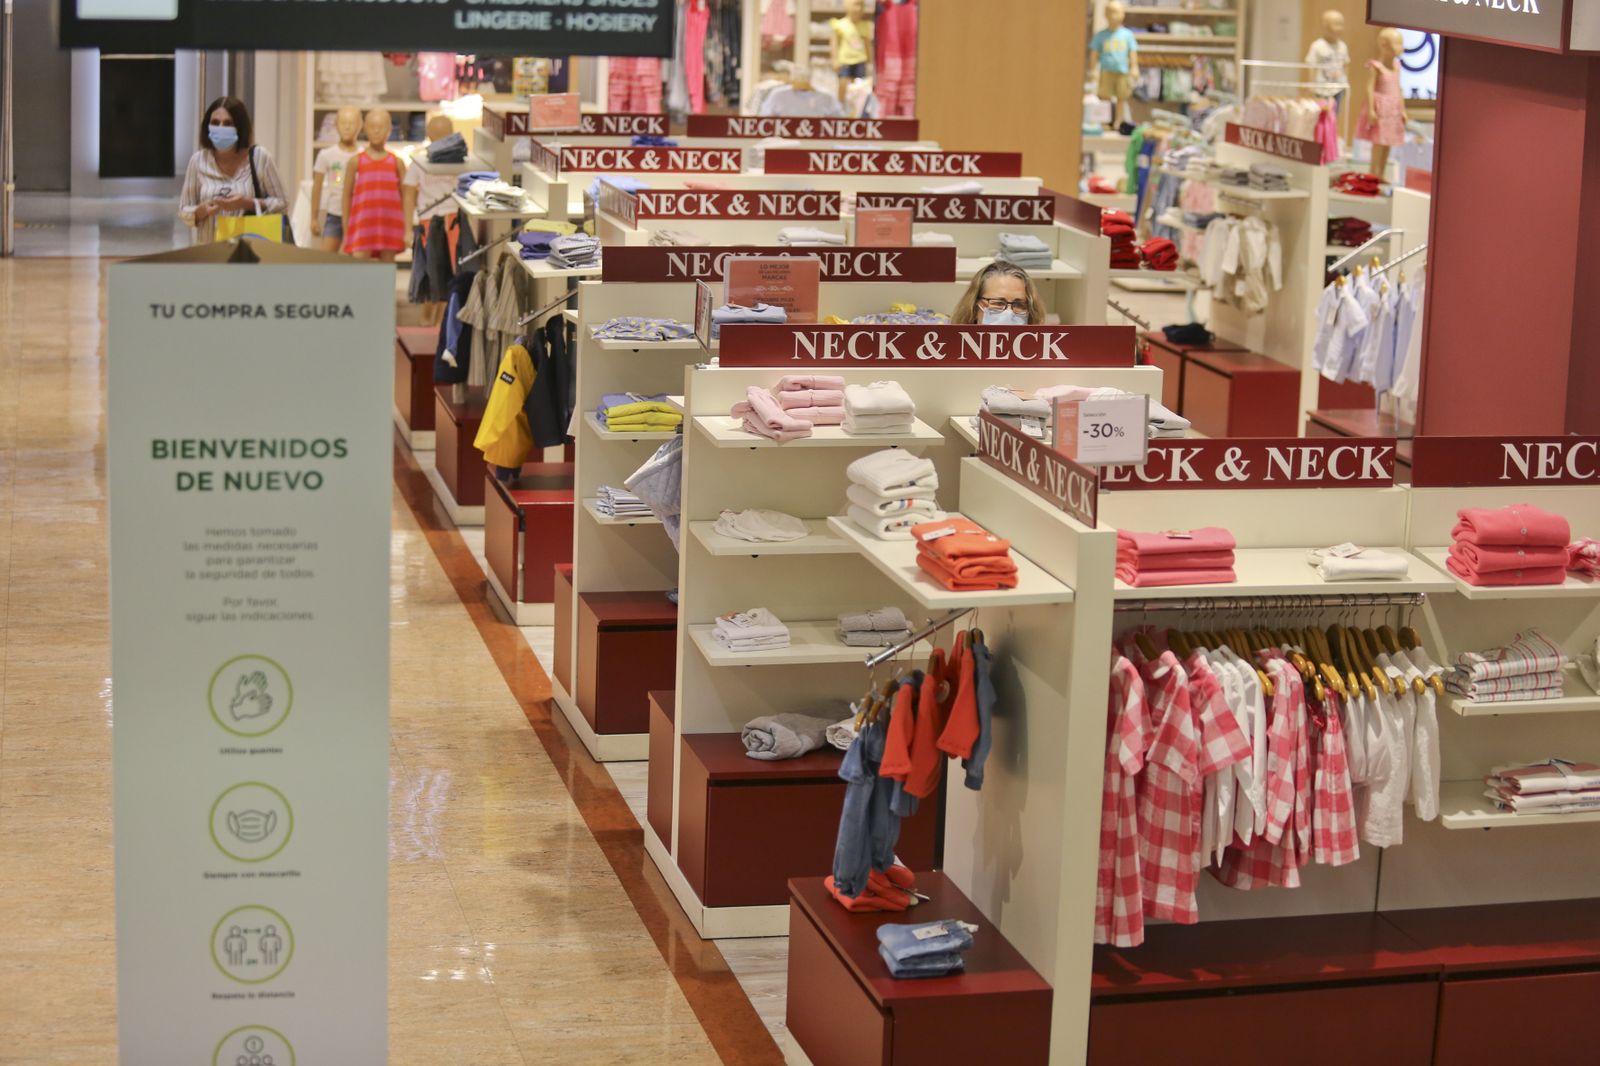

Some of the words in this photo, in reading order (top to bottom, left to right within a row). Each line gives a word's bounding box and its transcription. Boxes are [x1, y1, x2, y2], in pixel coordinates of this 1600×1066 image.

[455, 10, 552, 31] LINGERIE
[565, 12, 659, 32] HOSIERY
[602, 116, 664, 134] NECK
[727, 118, 791, 137] NECK
[796, 119, 814, 138] &
[819, 120, 882, 139] NECK
[562, 149, 634, 169] NECK
[640, 150, 660, 170] &
[667, 151, 740, 171] NECK
[808, 152, 879, 172] NECK
[885, 153, 905, 173] &
[911, 154, 981, 174] NECK
[637, 193, 721, 216] NECK
[727, 193, 750, 216] &
[758, 194, 840, 217] NECK
[944, 197, 966, 220] &
[974, 198, 1053, 221] NECK
[150, 303, 176, 319] TU
[181, 303, 268, 319] COMPRA
[274, 303, 354, 319] SEGURA
[791, 331, 906, 360] NECK
[916, 331, 947, 360] &
[958, 331, 1070, 361] NECK
[1083, 423, 1125, 438] -30%
[152, 438, 348, 459] BIENVENIDOS
[980, 418, 1024, 476] NECK
[1027, 447, 1041, 485] &
[1044, 455, 1095, 519] NECK
[1215, 446, 1250, 481] &
[1263, 446, 1394, 481] NECK
[1499, 442, 1600, 480] NEC
[176, 471, 214, 491] DE
[224, 471, 323, 491] NUEVO
